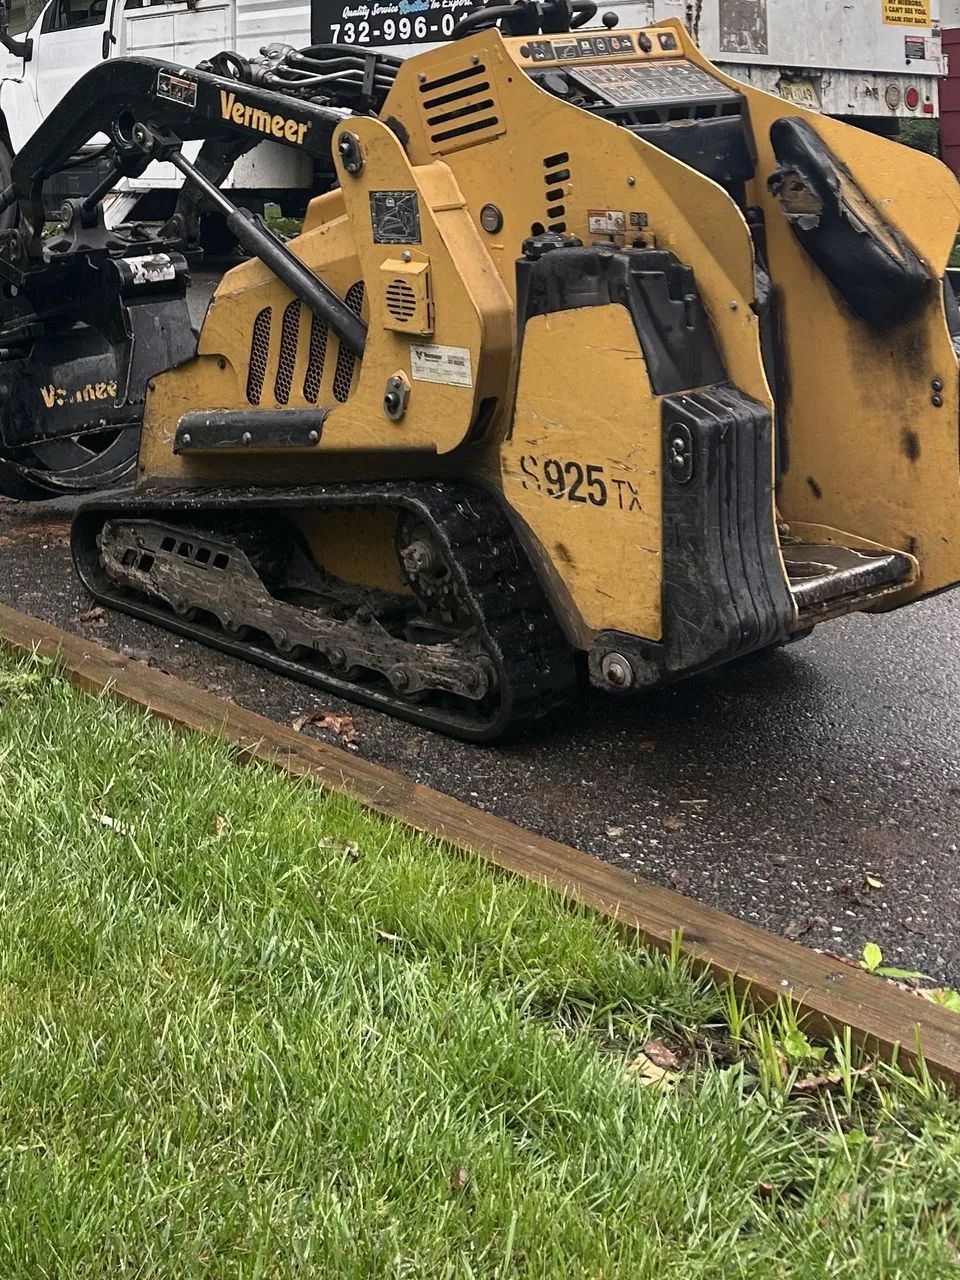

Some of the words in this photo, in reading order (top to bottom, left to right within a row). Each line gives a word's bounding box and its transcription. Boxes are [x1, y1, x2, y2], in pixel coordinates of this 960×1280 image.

[342, 5, 370, 20] Quality
[371, 2, 399, 16] Service
[888, 6, 903, 14] CAN'T
[330, 12, 503, 44] 732-996-0
